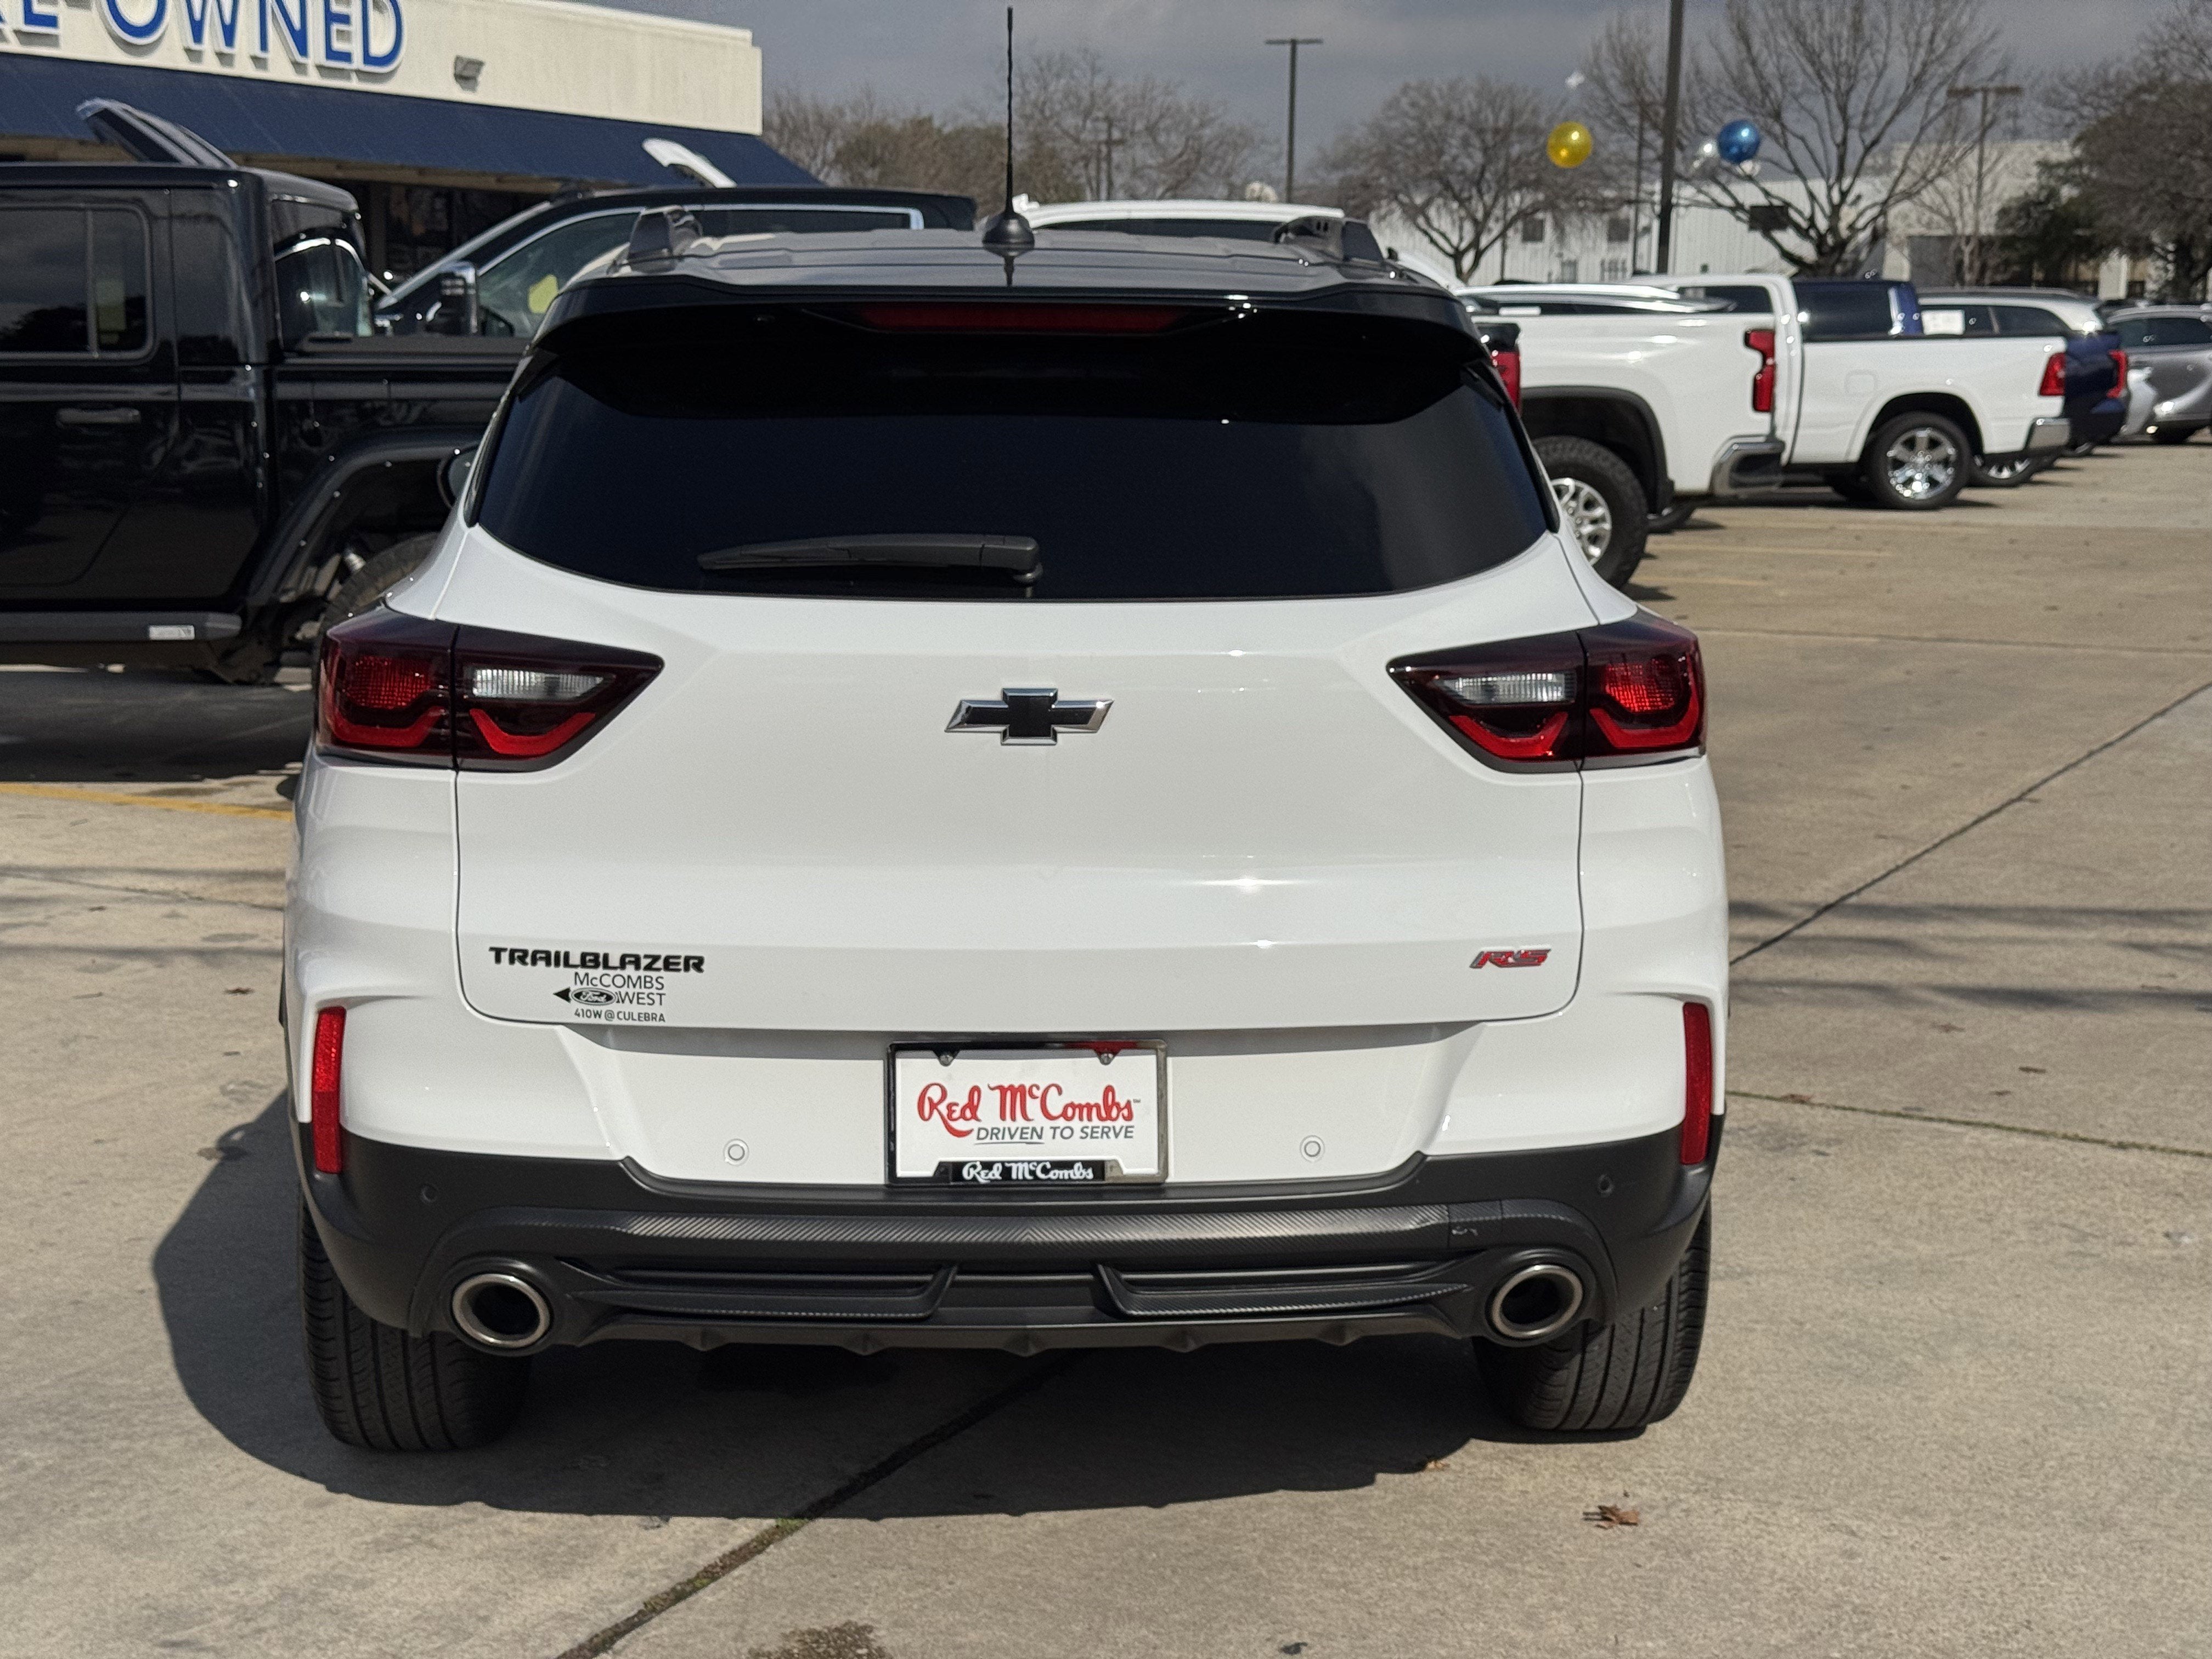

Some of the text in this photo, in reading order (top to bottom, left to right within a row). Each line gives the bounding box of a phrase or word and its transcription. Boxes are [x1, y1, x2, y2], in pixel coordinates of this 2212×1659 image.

[489, 947, 704, 973] TRAILBLAZER
[1469, 949, 1551, 969] RS
[574, 972, 665, 990] McCOMBS
[580, 991, 666, 1006] Ford WEST
[574, 1008, 602, 1019] 410W
[617, 1011, 665, 1022] CULEBRA
[917, 1082, 1133, 1138] Red McCombs
[976, 1125, 1135, 1141] DRIVEN TO SERVE
[962, 1161, 1093, 1183] Red McCombs
